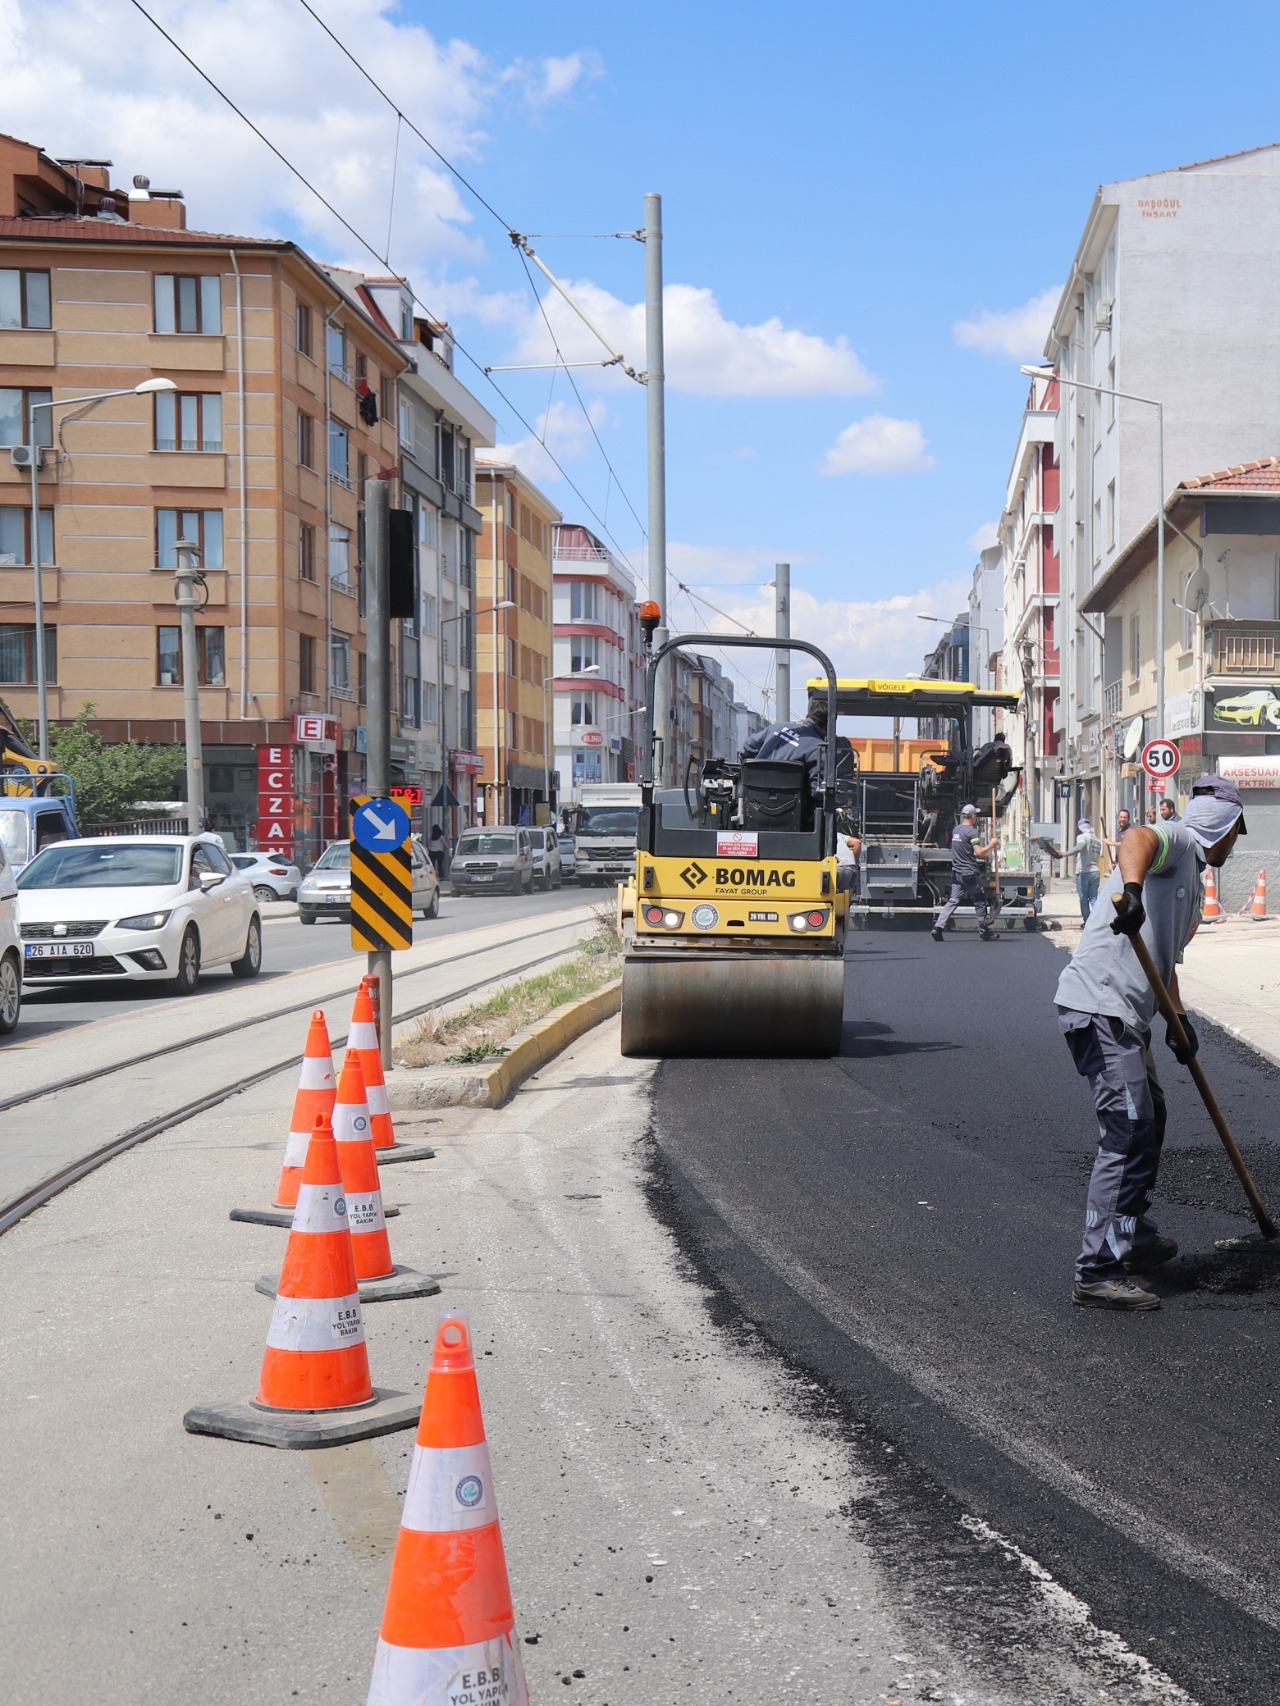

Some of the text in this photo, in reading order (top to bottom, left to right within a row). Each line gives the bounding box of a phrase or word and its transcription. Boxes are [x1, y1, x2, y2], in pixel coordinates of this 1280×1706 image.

[878, 682, 906, 691] VÖGELE
[304, 720, 318, 738] E
[1148, 750, 1174, 768] 50
[1223, 768, 1279, 777] AKSESUAR
[715, 868, 796, 887] BOMAG
[750, 913, 757, 921] 26
[31, 946, 44, 956] 26
[49, 945, 68, 956] AIA
[73, 943, 91, 955] 620
[354, 1204, 374, 1213] E.B.B
[349, 1212, 362, 1220] YOL
[355, 1217, 374, 1225] BAKIM
[337, 1308, 358, 1321] E.B.B
[332, 1321, 347, 1331] YOL
[339, 1326, 358, 1337] BAKIM
[462, 1667, 501, 1690] E.B.B
[450, 1692, 476, 1706] YOL
